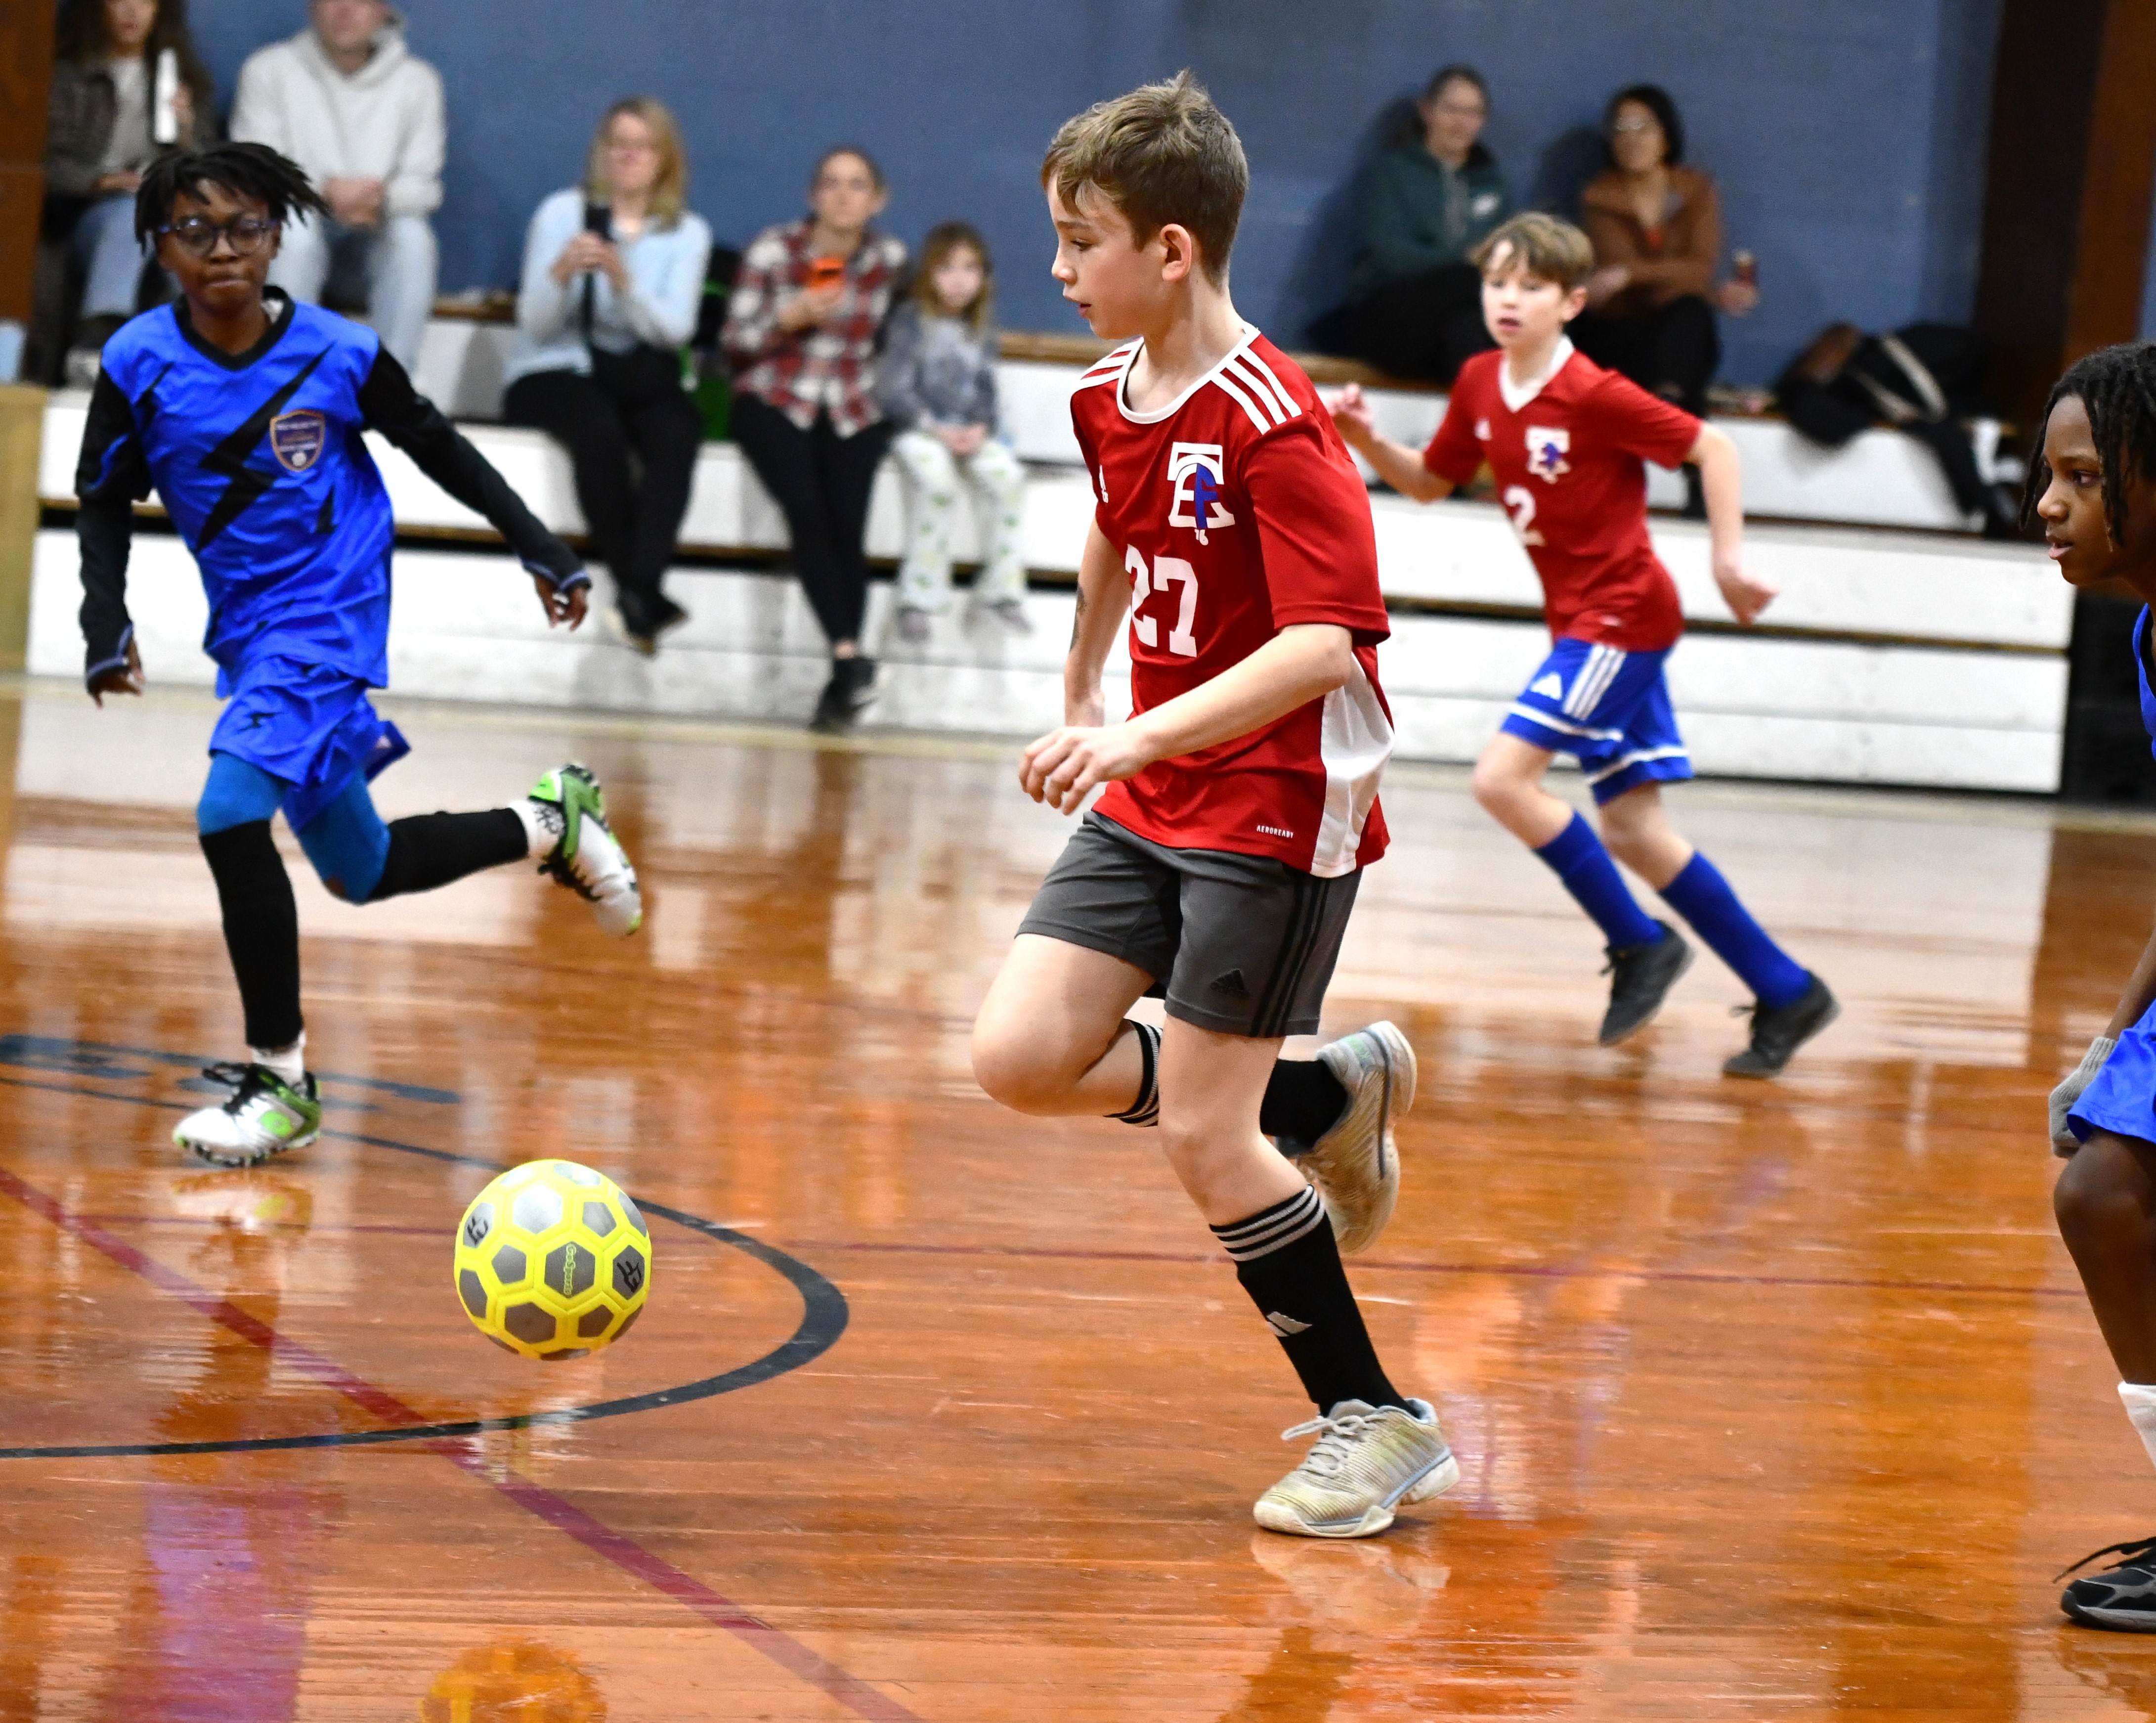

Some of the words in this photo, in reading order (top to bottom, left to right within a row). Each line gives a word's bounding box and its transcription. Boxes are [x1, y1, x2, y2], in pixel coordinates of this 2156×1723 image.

[1504, 486, 1546, 546] 2
[1125, 544, 1197, 658] 27
[1256, 825, 1294, 839] AEROREADY
